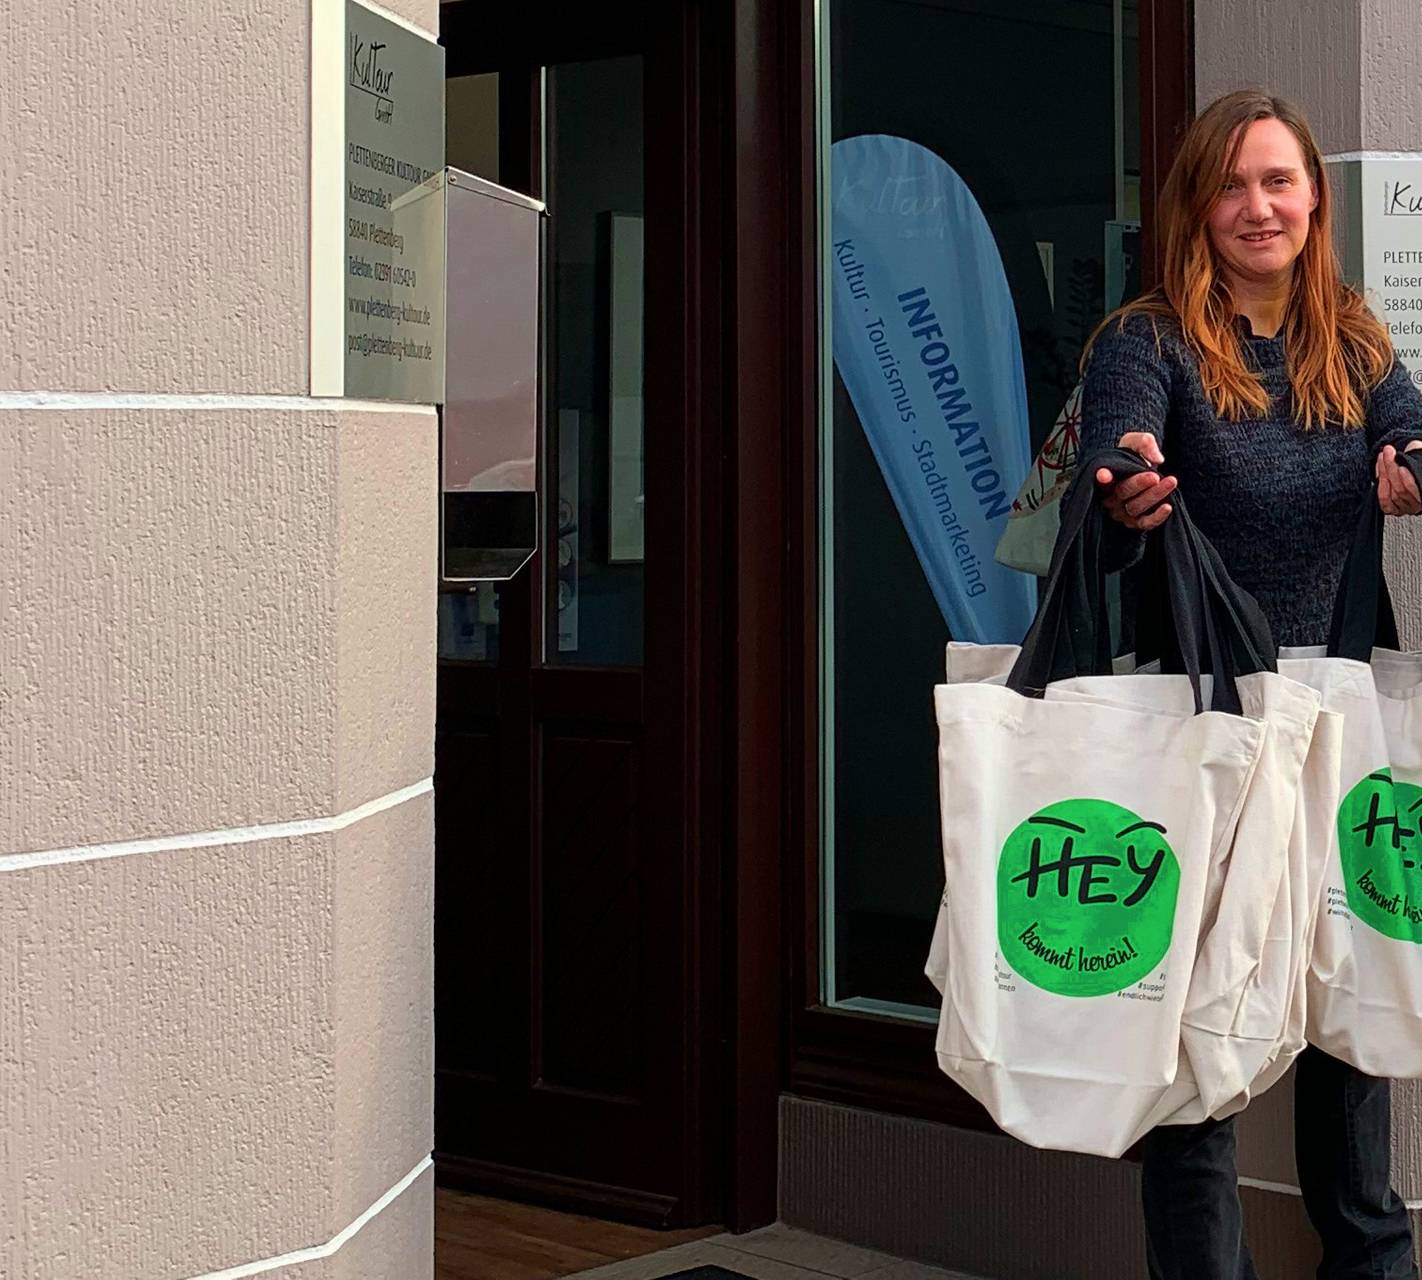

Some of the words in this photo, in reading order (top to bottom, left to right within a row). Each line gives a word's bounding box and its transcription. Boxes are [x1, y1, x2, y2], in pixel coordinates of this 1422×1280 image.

[349, 218, 369, 241] 58840
[369, 222, 404, 255] Plettenberg
[1384, 298, 1422, 311] 58840
[834, 239, 870, 300] Kultur
[865, 317, 916, 423] Tourismus
[912, 440, 987, 598] Stadtmarketing
[897, 287, 1012, 521] INFORMATION
[1011, 836, 1166, 907] HEY
[1357, 869, 1402, 916] kommt
[1018, 921, 1076, 971] kommt
[1078, 937, 1139, 972] herein!
